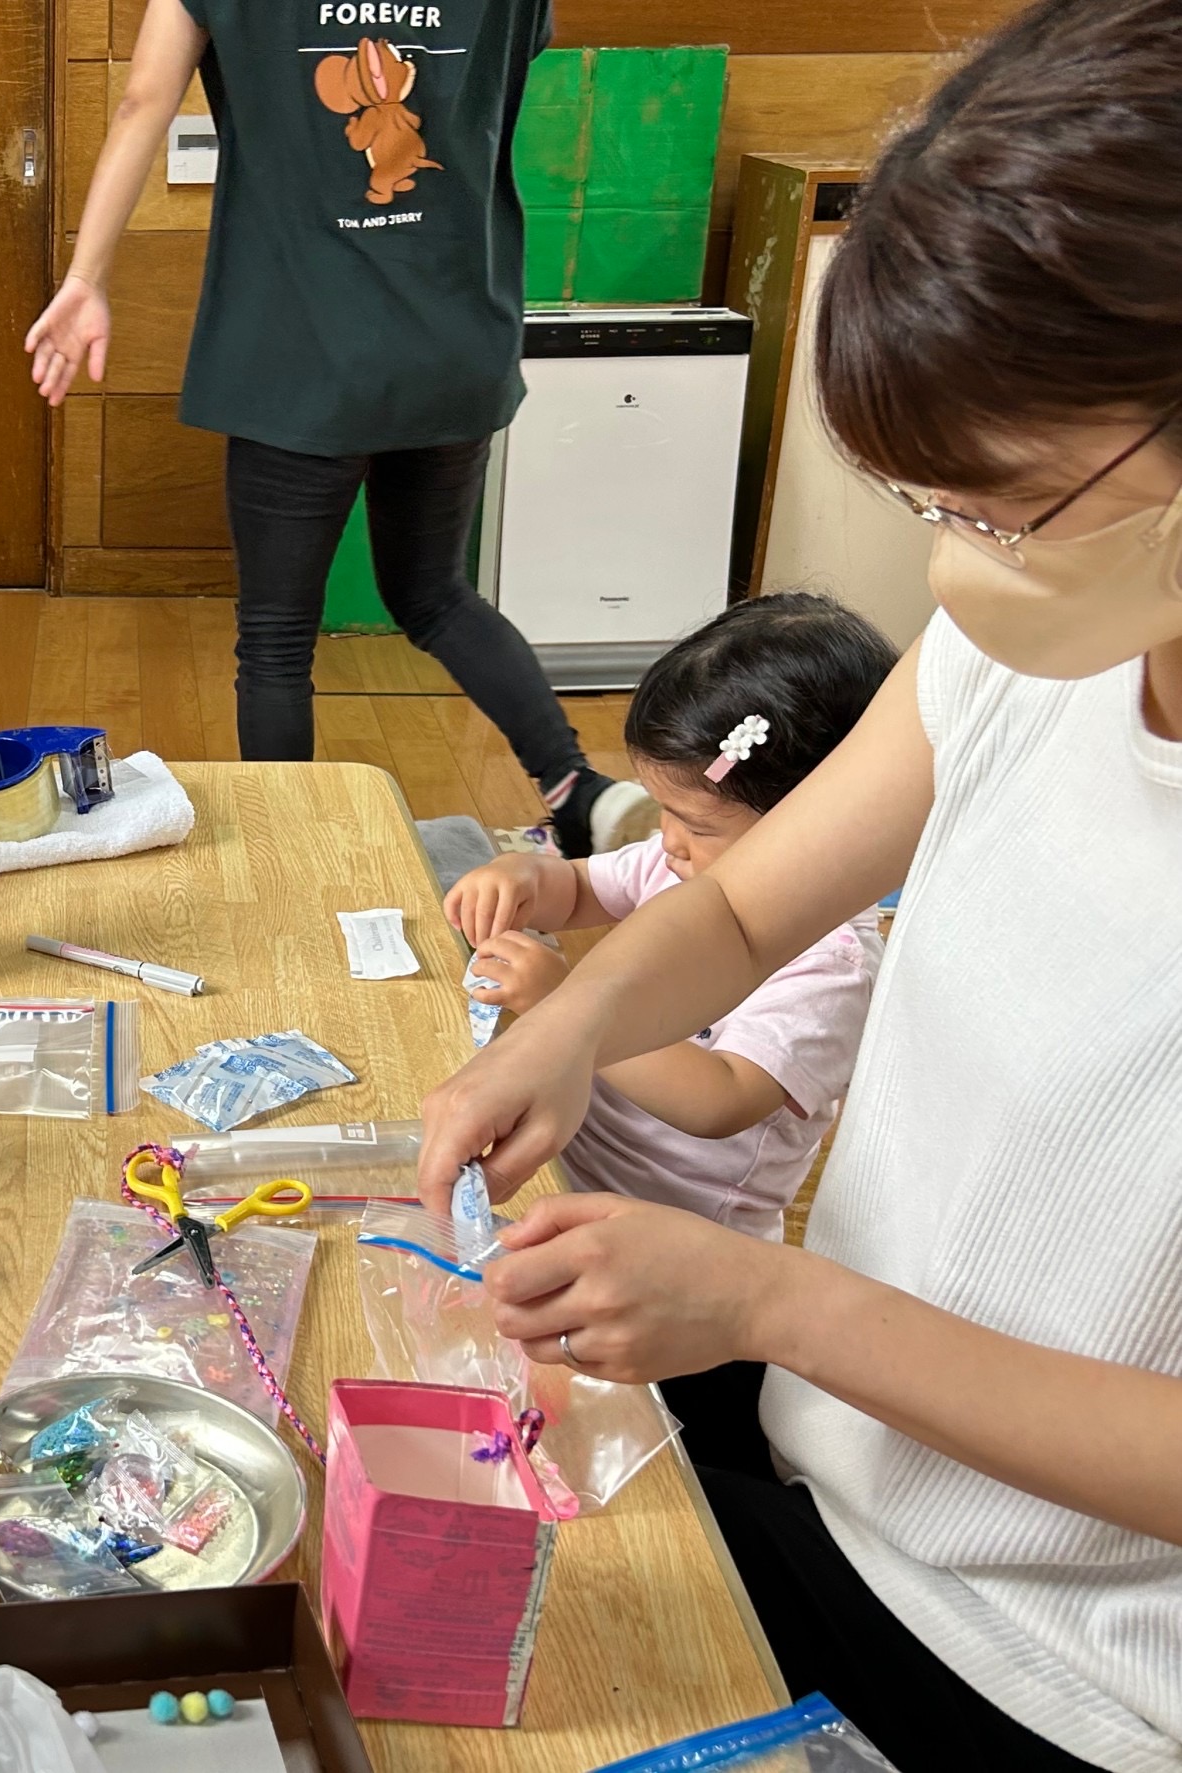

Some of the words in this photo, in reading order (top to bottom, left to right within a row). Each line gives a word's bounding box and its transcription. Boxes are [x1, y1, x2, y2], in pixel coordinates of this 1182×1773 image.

[319, 2, 441, 28] FOREVER
[337, 218, 360, 229] TOM
[362, 216, 387, 229] AND
[388, 212, 423, 225] JERRY
